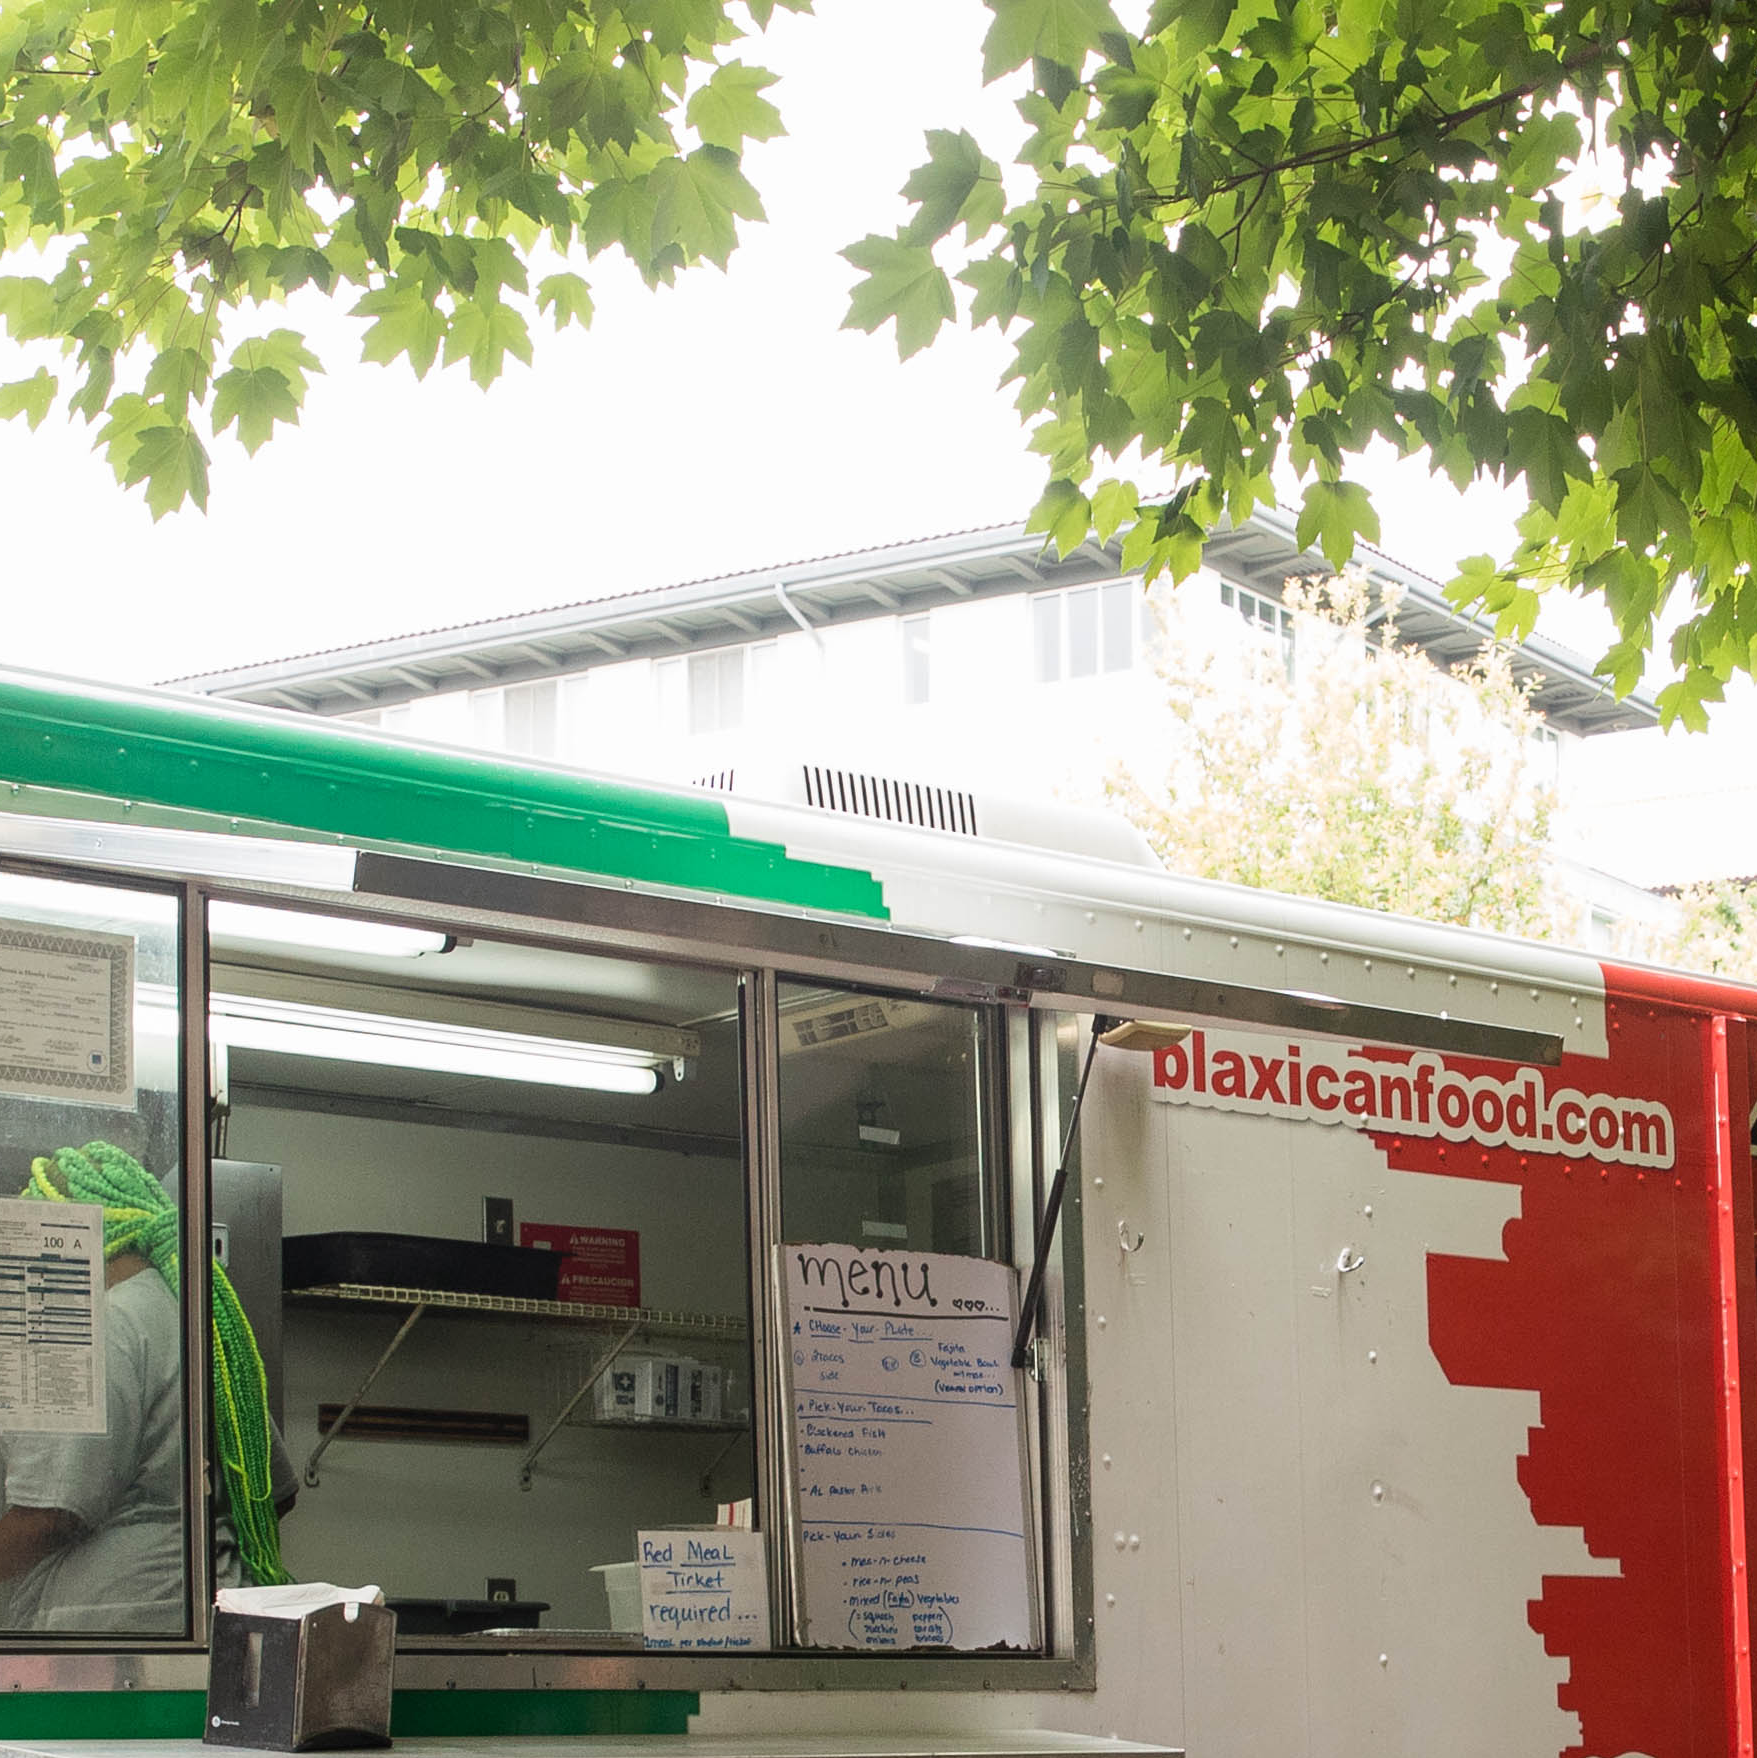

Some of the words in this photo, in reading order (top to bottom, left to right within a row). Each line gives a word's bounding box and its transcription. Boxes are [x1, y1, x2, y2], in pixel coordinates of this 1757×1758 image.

[1151, 1040, 1670, 1158] blaxicanfood.com
[43, 1236, 65, 1249] 100
[73, 1239, 83, 1249] A
[797, 1253, 938, 1308] menu
[643, 1541, 673, 1564] Red
